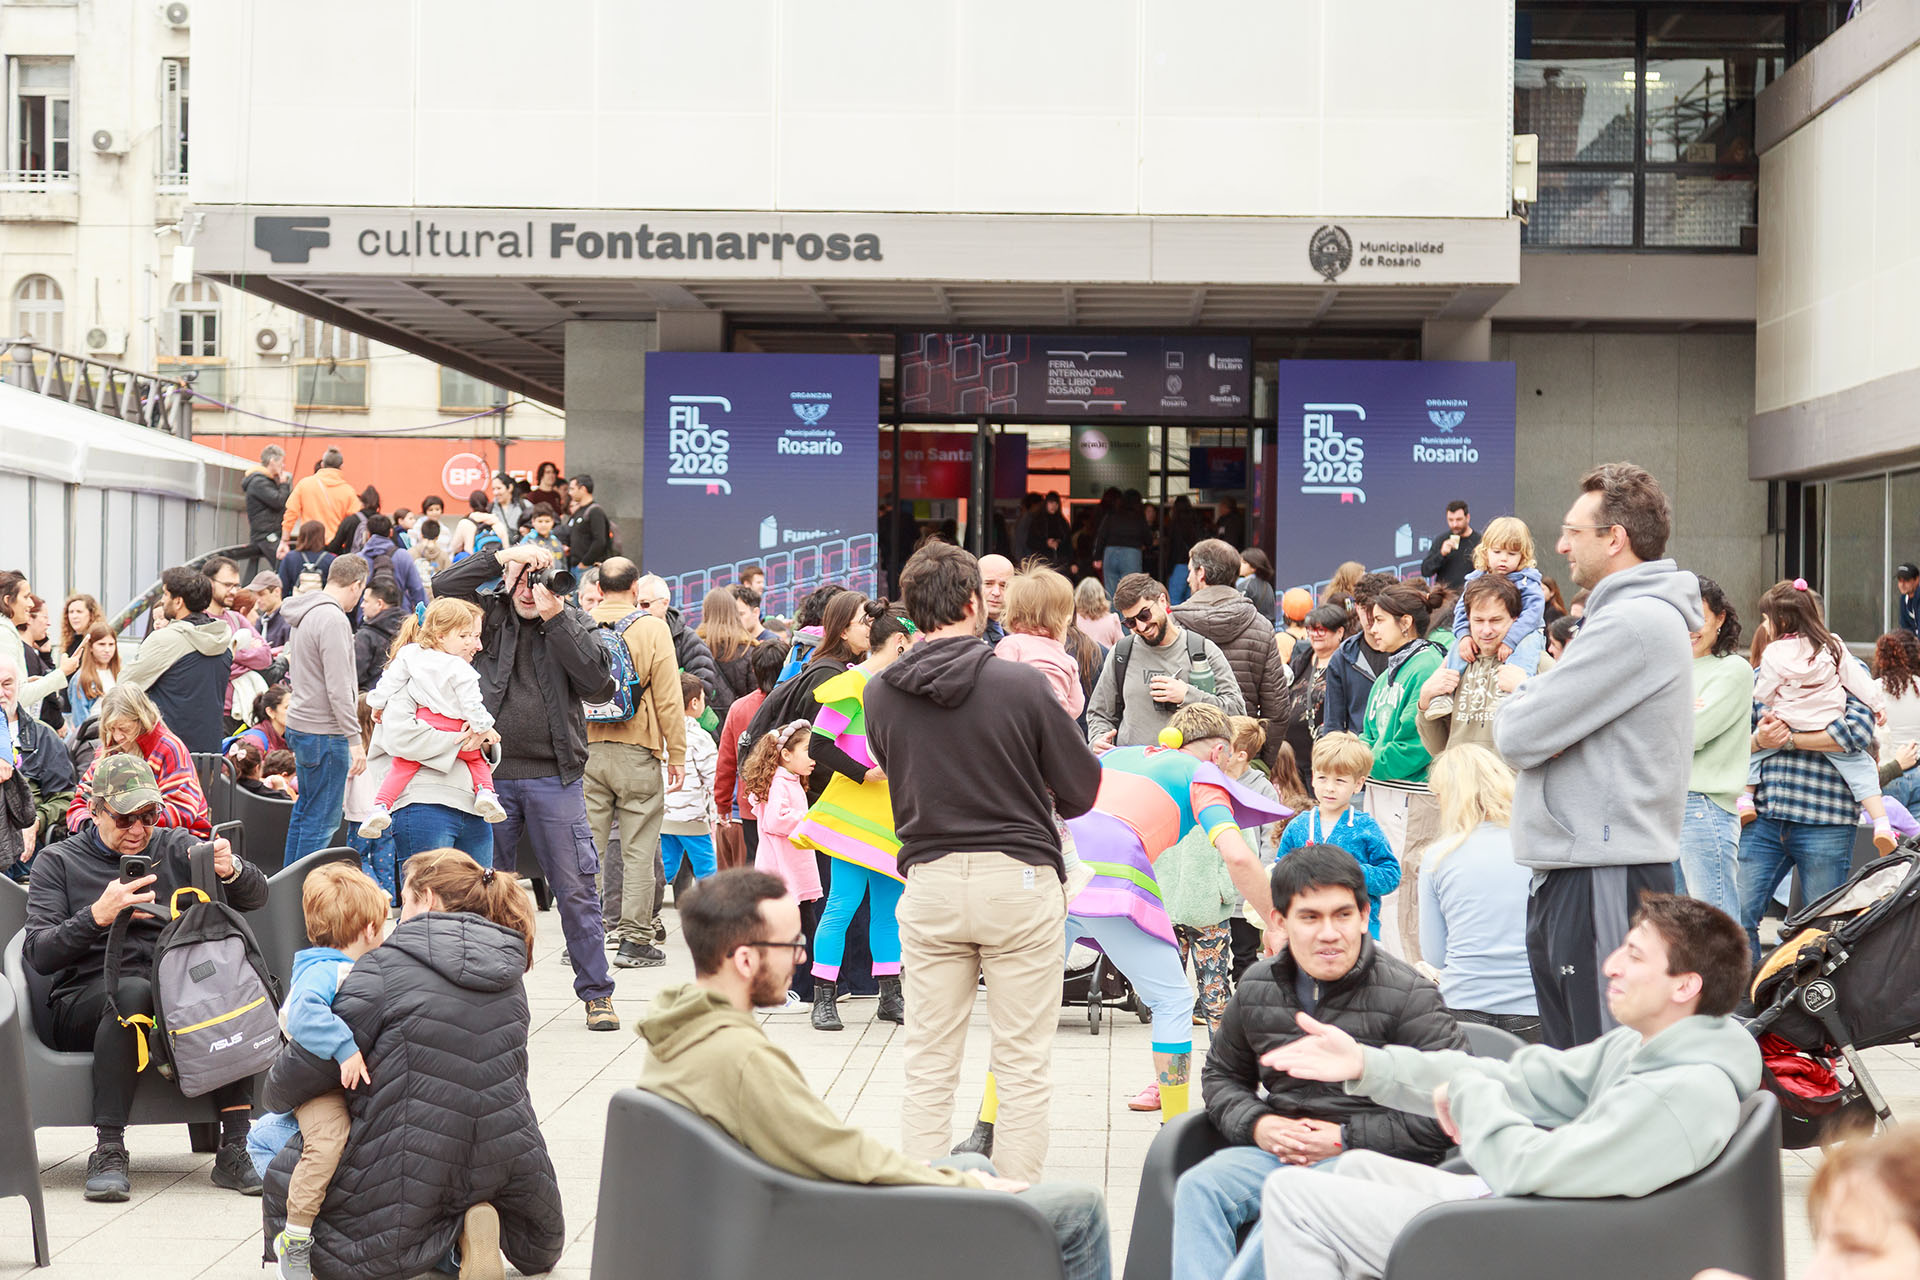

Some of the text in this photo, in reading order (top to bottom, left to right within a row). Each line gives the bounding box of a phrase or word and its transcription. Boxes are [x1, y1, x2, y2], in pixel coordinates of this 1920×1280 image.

[358, 220, 883, 262] cultural Fontanarrosa
[1360, 241, 1444, 254] Municipalidad
[1360, 255, 1421, 267] de Rosario
[1048, 360, 1075, 368] FERIA
[1048, 369, 1124, 378] INTERNACIONAL
[1048, 378, 1097, 386] DEL LIBRO
[1048, 386, 1091, 395] ROSARIO
[1426, 399, 1468, 407] ORGANIZAN
[669, 406, 709, 430] FIL
[1304, 413, 1344, 439] FIL
[669, 429, 730, 454] ROS
[777, 436, 843, 455] Rosario
[1304, 437, 1364, 462] ROS
[903, 449, 924, 460] en
[927, 448, 973, 461] Santa
[1413, 444, 1479, 463] Rosario
[669, 453, 729, 475] 2026
[1303, 461, 1363, 483] 2026
[449, 468, 482, 485] BP
[209, 1031, 243, 1053] ASUS
